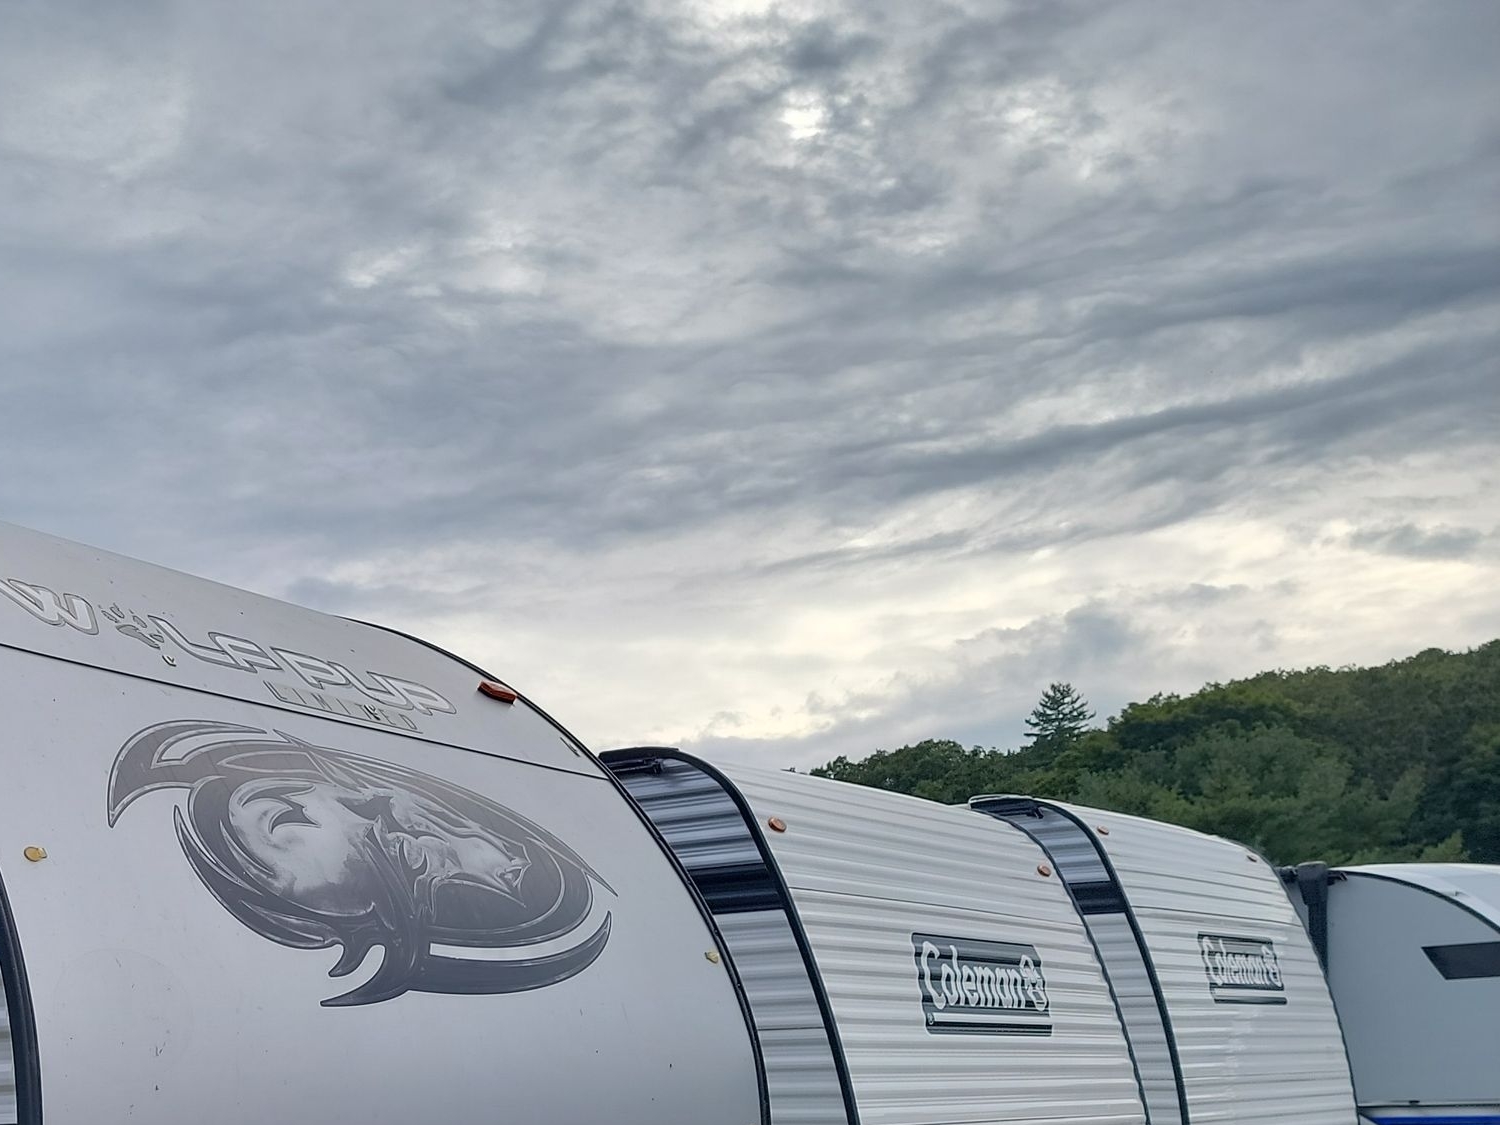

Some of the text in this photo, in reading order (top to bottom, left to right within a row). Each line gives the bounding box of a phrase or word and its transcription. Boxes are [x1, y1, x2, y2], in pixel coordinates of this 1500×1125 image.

[263, 680, 420, 732] LIMITED
[270, 645, 457, 716] PUP
[922, 939, 1024, 1009] Coleman
[1201, 935, 1268, 988] Coleman
